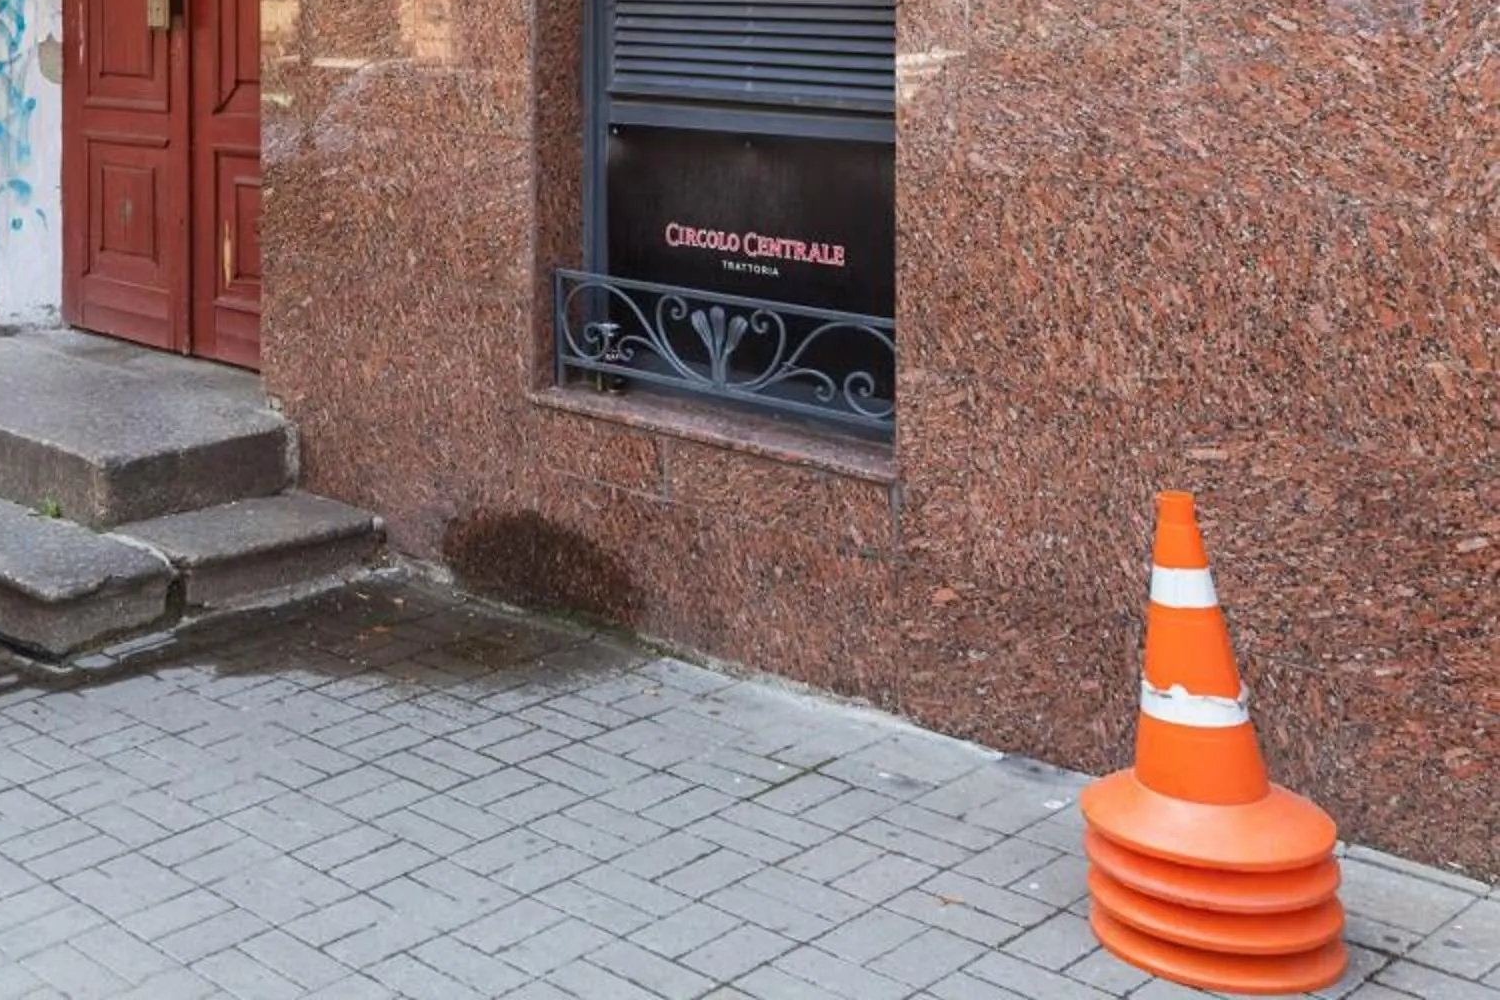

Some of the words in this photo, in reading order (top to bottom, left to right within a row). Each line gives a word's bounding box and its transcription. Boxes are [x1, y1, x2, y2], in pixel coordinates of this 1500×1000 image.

[665, 222, 741, 252] CIRCOLO
[743, 231, 845, 267] CENTRALE
[722, 259, 780, 277] TRATTORIA
